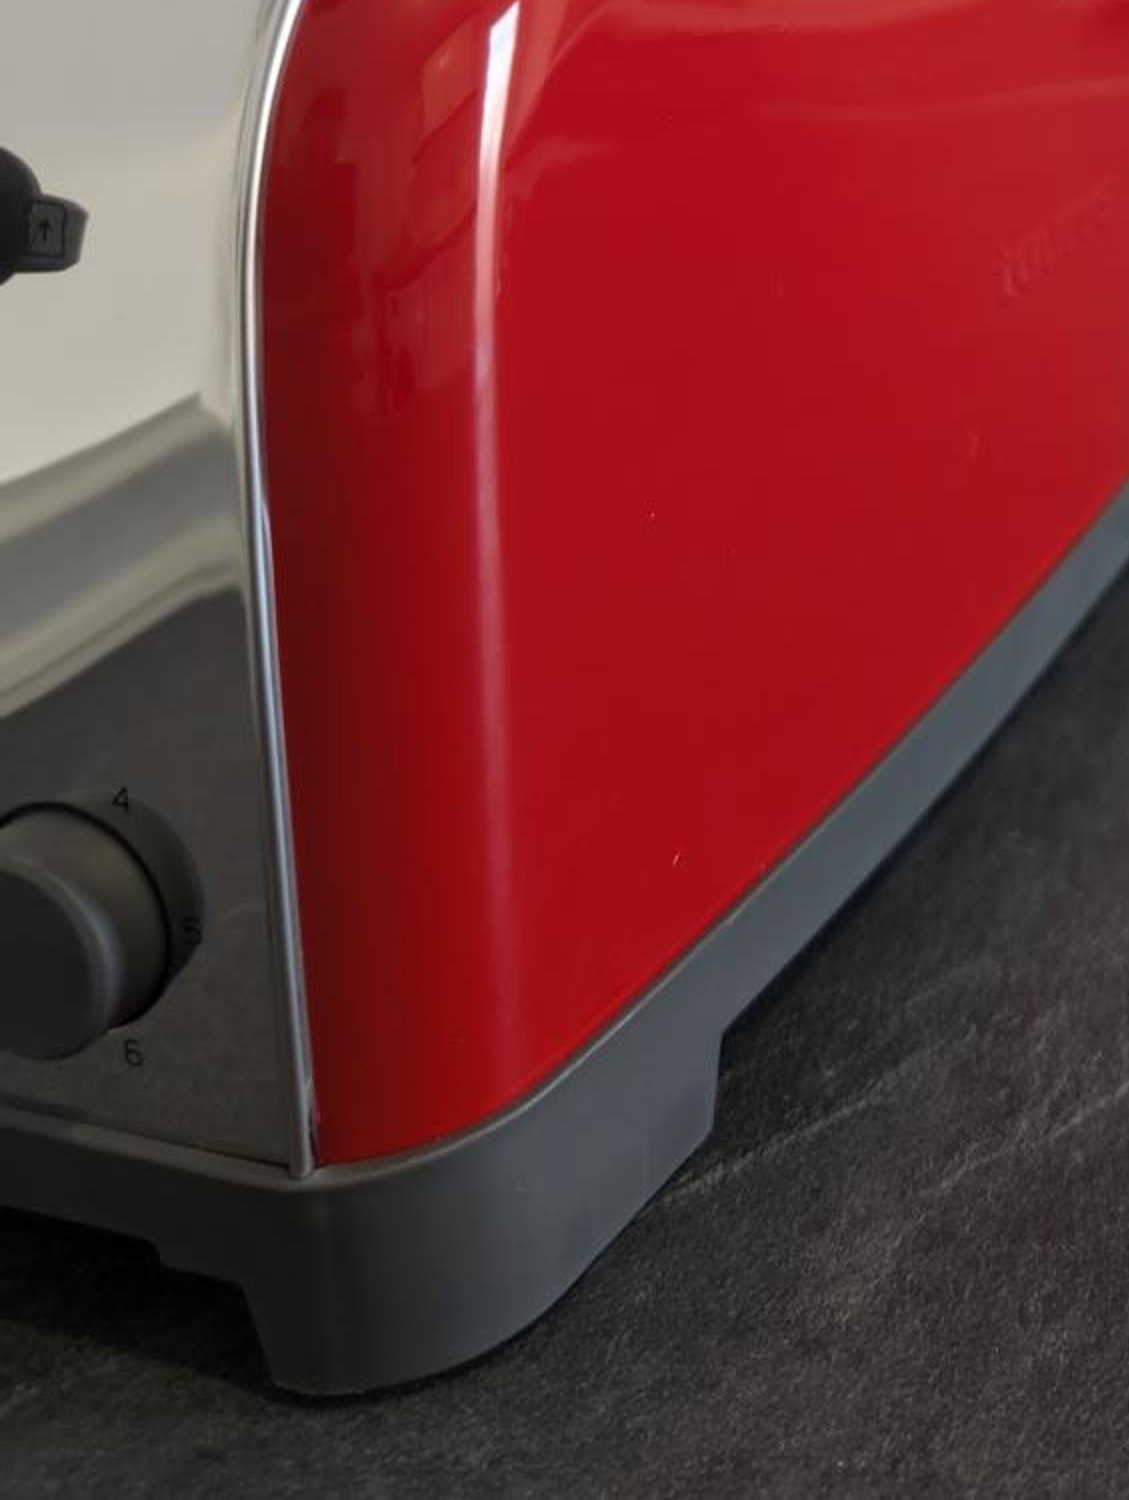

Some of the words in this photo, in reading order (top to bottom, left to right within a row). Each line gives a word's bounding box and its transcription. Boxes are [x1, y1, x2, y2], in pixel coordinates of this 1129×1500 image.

[112, 787, 131, 813] 4
[183, 917, 203, 946] 5
[124, 1039, 144, 1067] 6
